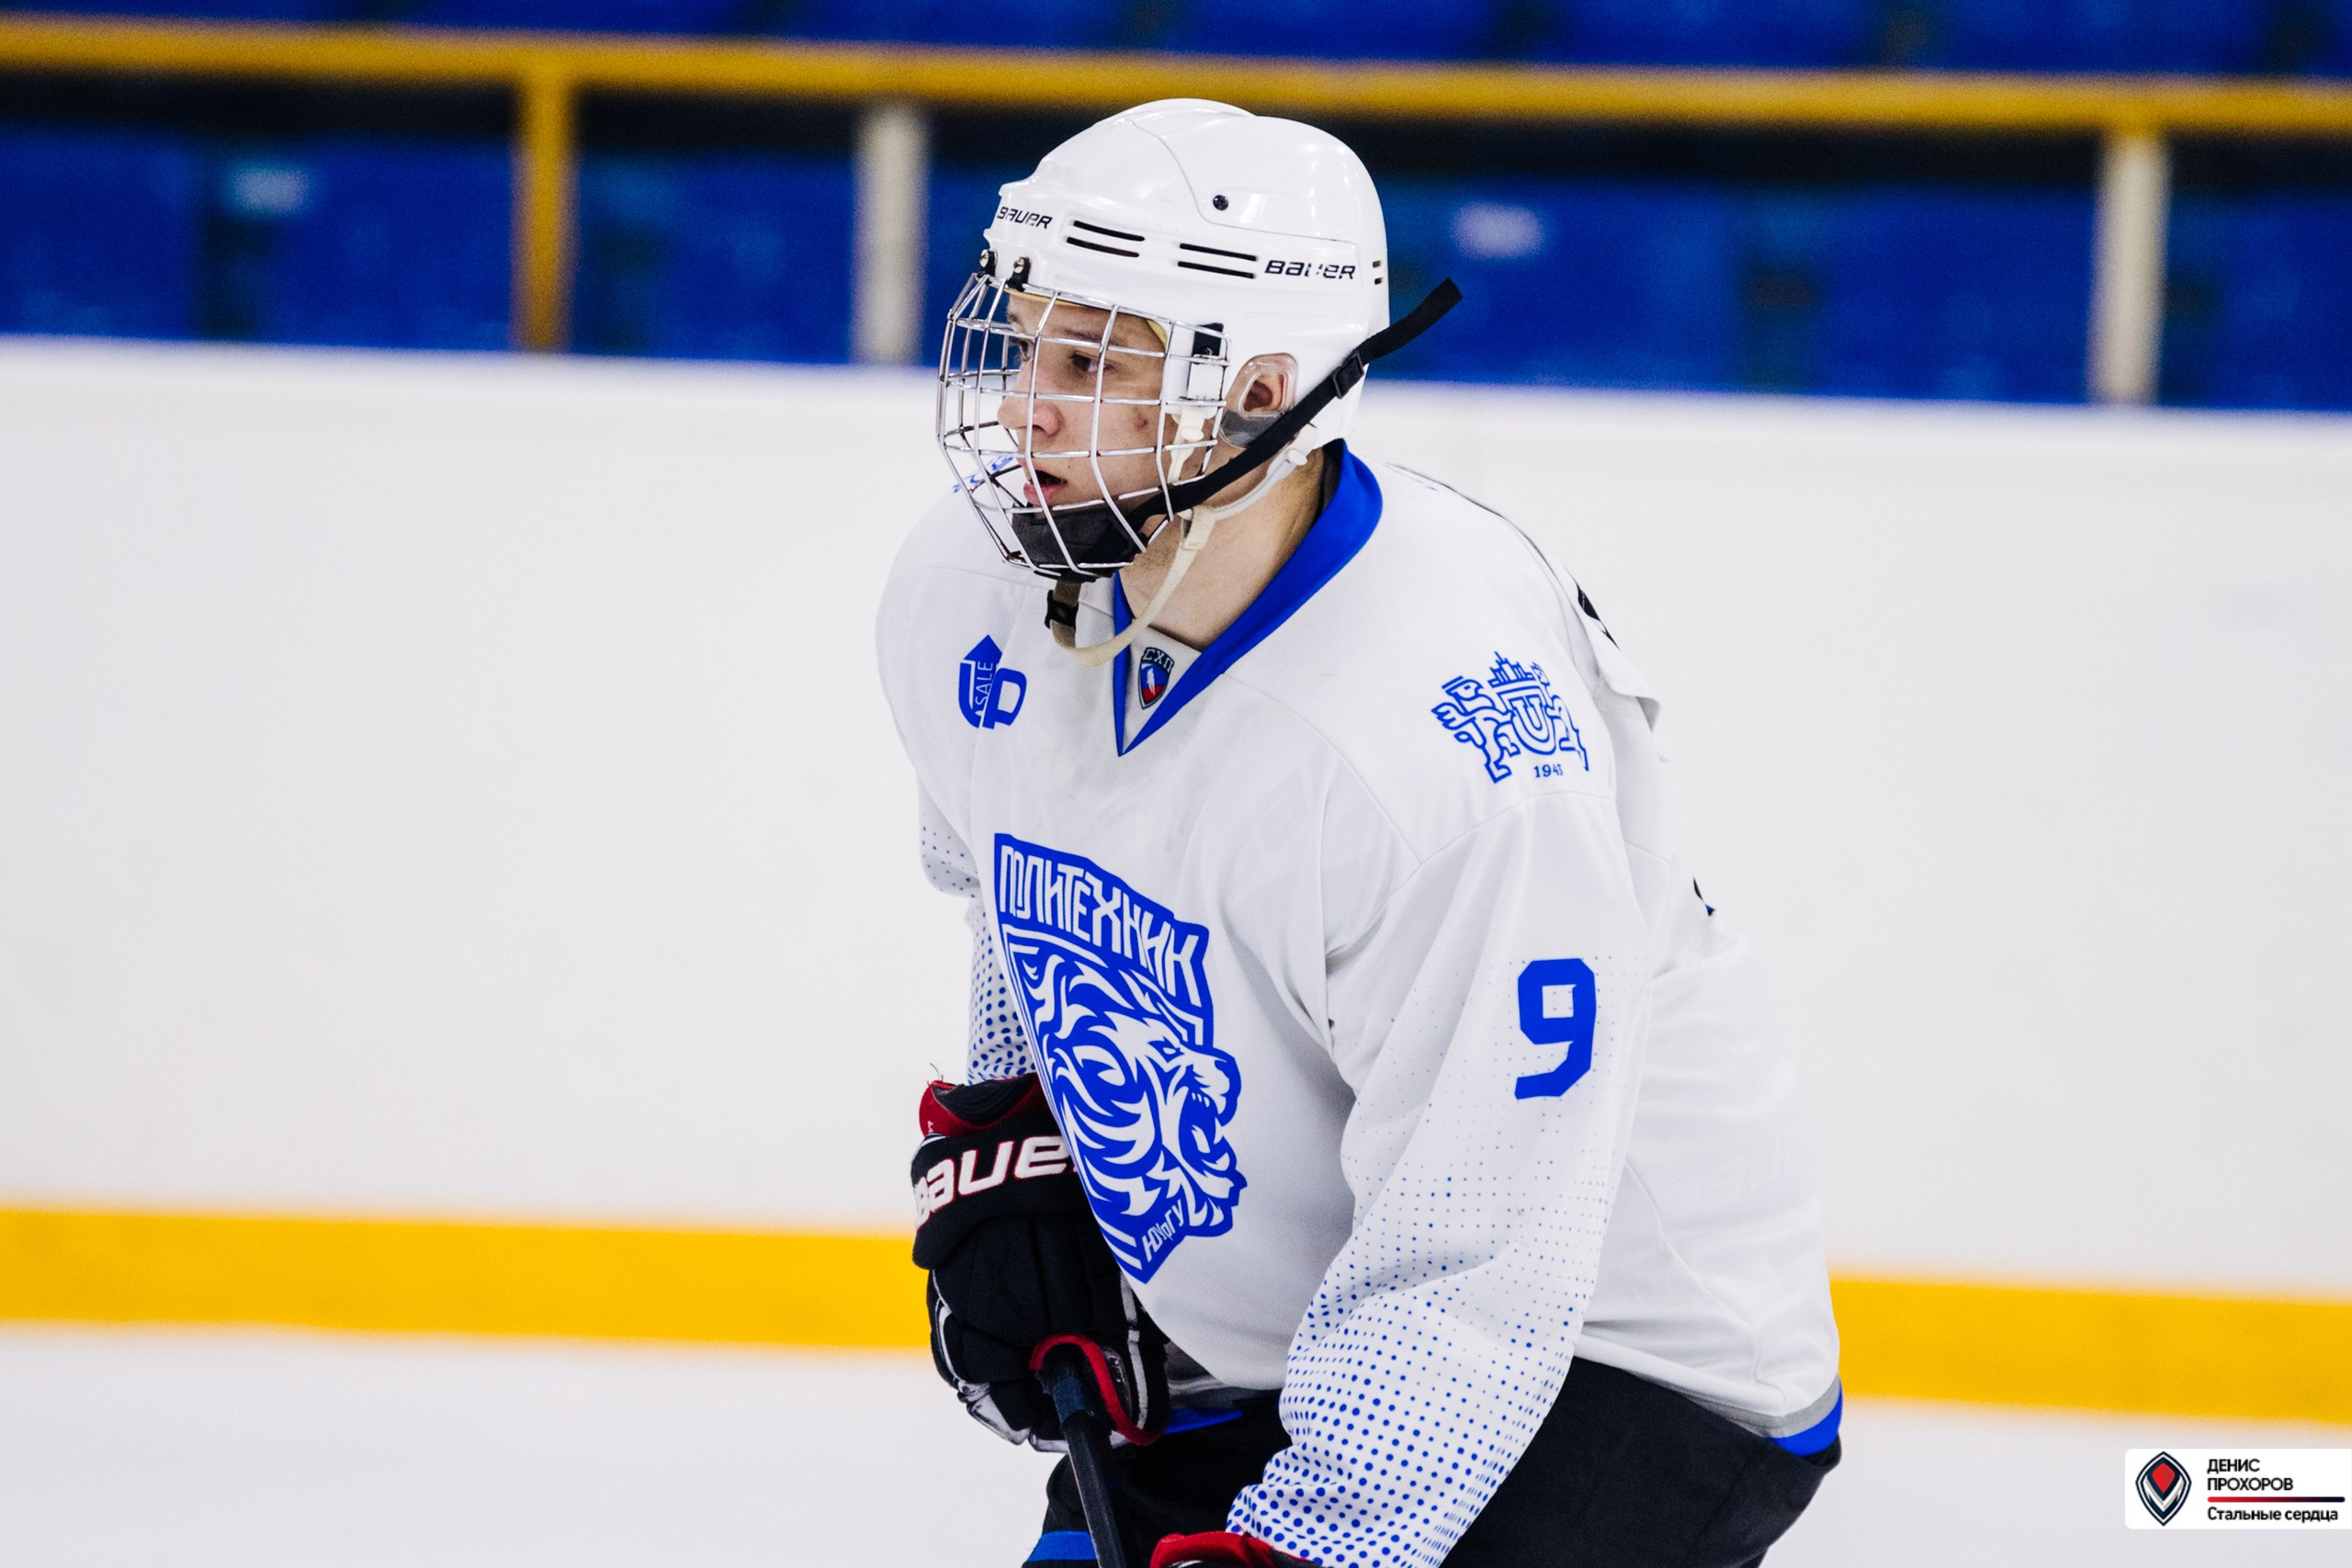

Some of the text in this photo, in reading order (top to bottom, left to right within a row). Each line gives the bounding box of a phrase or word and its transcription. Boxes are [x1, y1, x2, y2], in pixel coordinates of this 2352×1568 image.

[975, 661, 993, 705] SALE
[1000, 844, 1203, 1008] ПОЛИТЕХНИК
[1515, 958, 1597, 1100] 9
[915, 1135, 1079, 1230] BAUE
